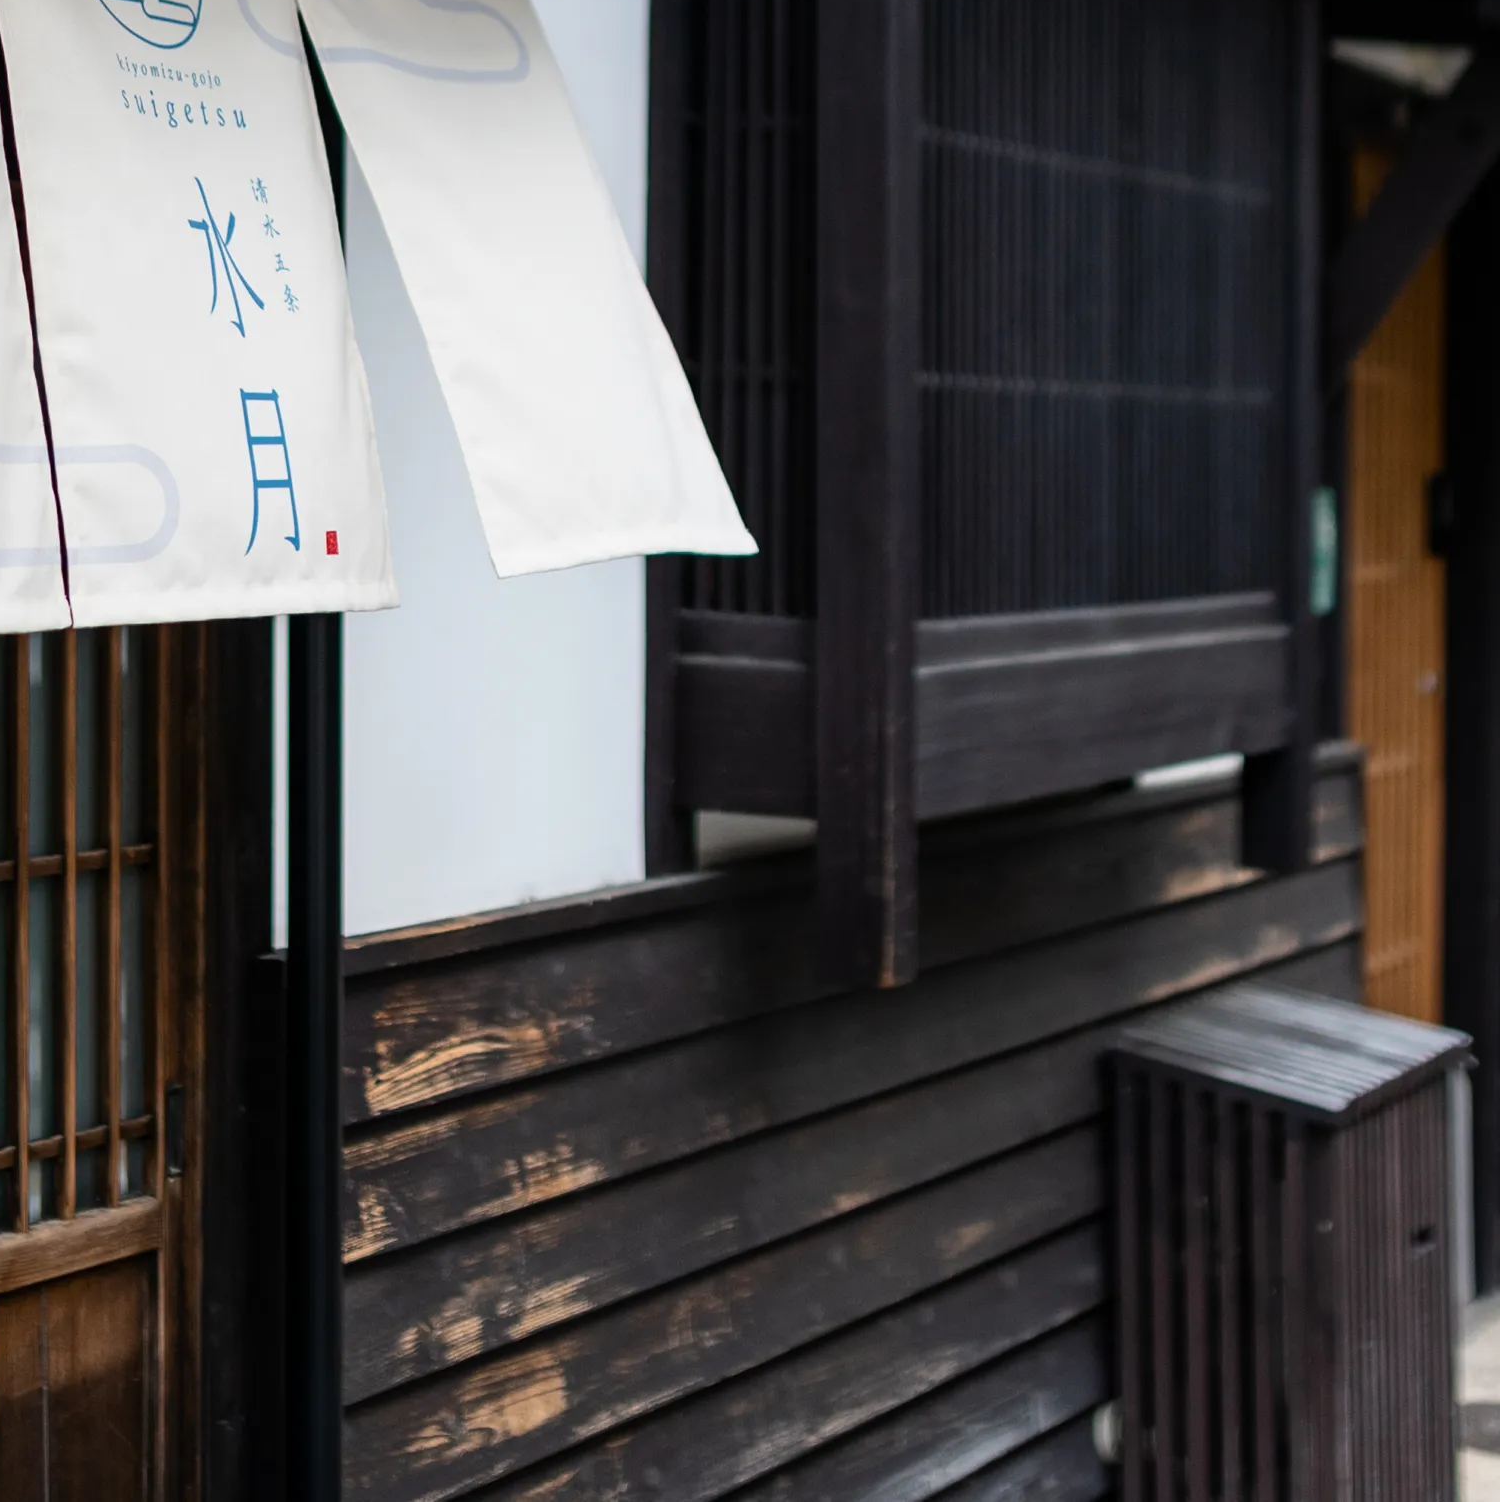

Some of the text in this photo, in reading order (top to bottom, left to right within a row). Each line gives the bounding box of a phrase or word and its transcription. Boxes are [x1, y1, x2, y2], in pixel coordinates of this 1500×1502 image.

[116, 52, 222, 89] kiyomizu-gojo
[121, 89, 247, 128] suigetsu
[249, 177, 300, 313] 清水五条
[188, 175, 301, 557] 水月
